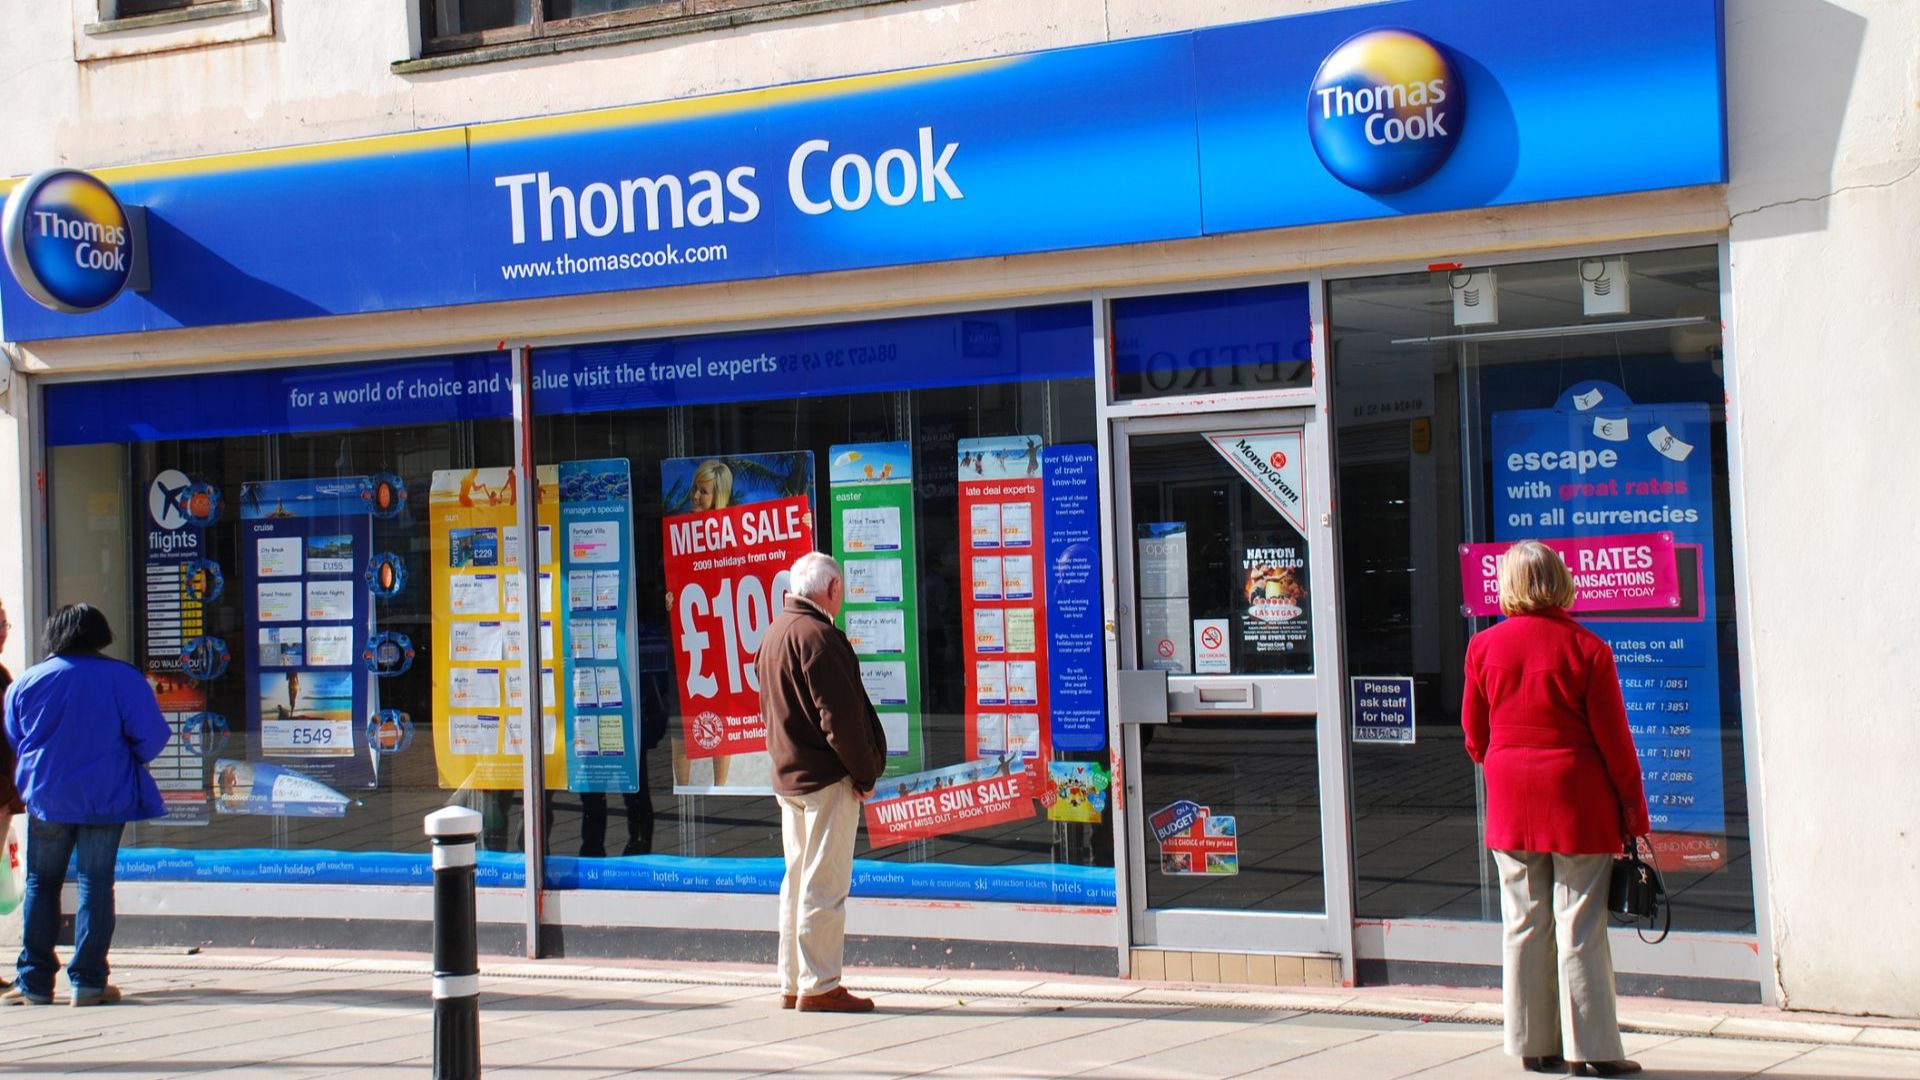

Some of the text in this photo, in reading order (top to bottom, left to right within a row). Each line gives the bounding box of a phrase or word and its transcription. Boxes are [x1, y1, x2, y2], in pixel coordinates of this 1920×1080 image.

[1317, 78, 1446, 119] Thomas
[1364, 108, 1447, 145] Cook
[495, 127, 964, 244] Thomas Cook
[34, 211, 125, 246] Thomas
[75, 243, 125, 272] Cook
[501, 243, 728, 281] www.thomascook.com
[290, 352, 778, 408] for a world of choice and value visit the travel experts
[1044, 455, 1093, 464] over 160 years
[1507, 449, 1618, 474] escape
[1063, 466, 1083, 474] travel
[1236, 439, 1299, 504] MoneyGram
[1052, 478, 1087, 486] know-how
[966, 484, 1036, 497] late deal experts
[1507, 479, 1687, 501] with great rates
[836, 492, 862, 502] easter
[563, 505, 624, 516] manager's specials
[1508, 505, 1698, 527] on all currencies
[445, 513, 460, 522] sun
[254, 524, 274, 532] cruise
[669, 505, 803, 557] MEGA SALE
[149, 531, 197, 553] flights
[474, 549, 493, 559] £229
[1145, 543, 1179, 556] open
[1246, 547, 1295, 560] HATTON
[693, 549, 787, 572] 2009 holidays from only
[1579, 545, 1653, 571] RATES
[1243, 560, 1250, 569] V
[849, 567, 866, 576] Egypt
[1483, 572, 1655, 593] FO ANSACTIONS
[1582, 587, 1655, 600] MONEY TODAY
[1254, 609, 1269, 617] LAS
[848, 618, 878, 626] Cadbury's
[1615, 638, 1684, 650] rates on all
[1613, 651, 1664, 663] encies...
[149, 659, 161, 670] GO
[875, 670, 893, 679] Wight
[1364, 683, 1400, 694] Please
[1625, 679, 1688, 688] SELL AT 1.0851
[1360, 697, 1407, 708] ask staff
[1626, 702, 1689, 711] SELL AT 1.3851
[726, 715, 741, 727] You
[1362, 711, 1405, 724] for help
[292, 727, 332, 745] £549
[728, 727, 768, 742] our holida
[1646, 725, 1657, 735] AT
[1661, 725, 1691, 735] 1.7295
[1647, 749, 1658, 757] AT
[1648, 772, 1659, 781] AT
[221, 793, 248, 802] discover
[876, 793, 940, 825] WINTER
[940, 786, 973, 813] SUN
[976, 779, 1020, 805] SALE
[1649, 795, 1659, 804] AT
[889, 801, 1011, 833] DON'T MISS OUT BOOK TODAY
[1157, 813, 1194, 840] BUDGET
[1655, 841, 1680, 852] SEND
[1681, 839, 1719, 851] MONEY
[126, 862, 156, 874] holidays
[167, 859, 194, 868] vouchers
[316, 861, 354, 872] gift vouchers
[259, 864, 315, 876] family holidays
[411, 865, 423, 876] ski
[502, 871, 526, 881] car hire
[587, 870, 599, 880] ski
[653, 870, 680, 882] hotels
[682, 876, 709, 886] car hire
[716, 876, 734, 886] deals
[735, 874, 757, 886] flights
[859, 872, 905, 884] gift vouchers
[911, 878, 929, 887] tours
[937, 879, 971, 888] excursions
[975, 877, 988, 890] ski
[991, 878, 1048, 889] attraction tickets
[1051, 880, 1082, 893] hotels
[1086, 886, 1117, 898] car hire
